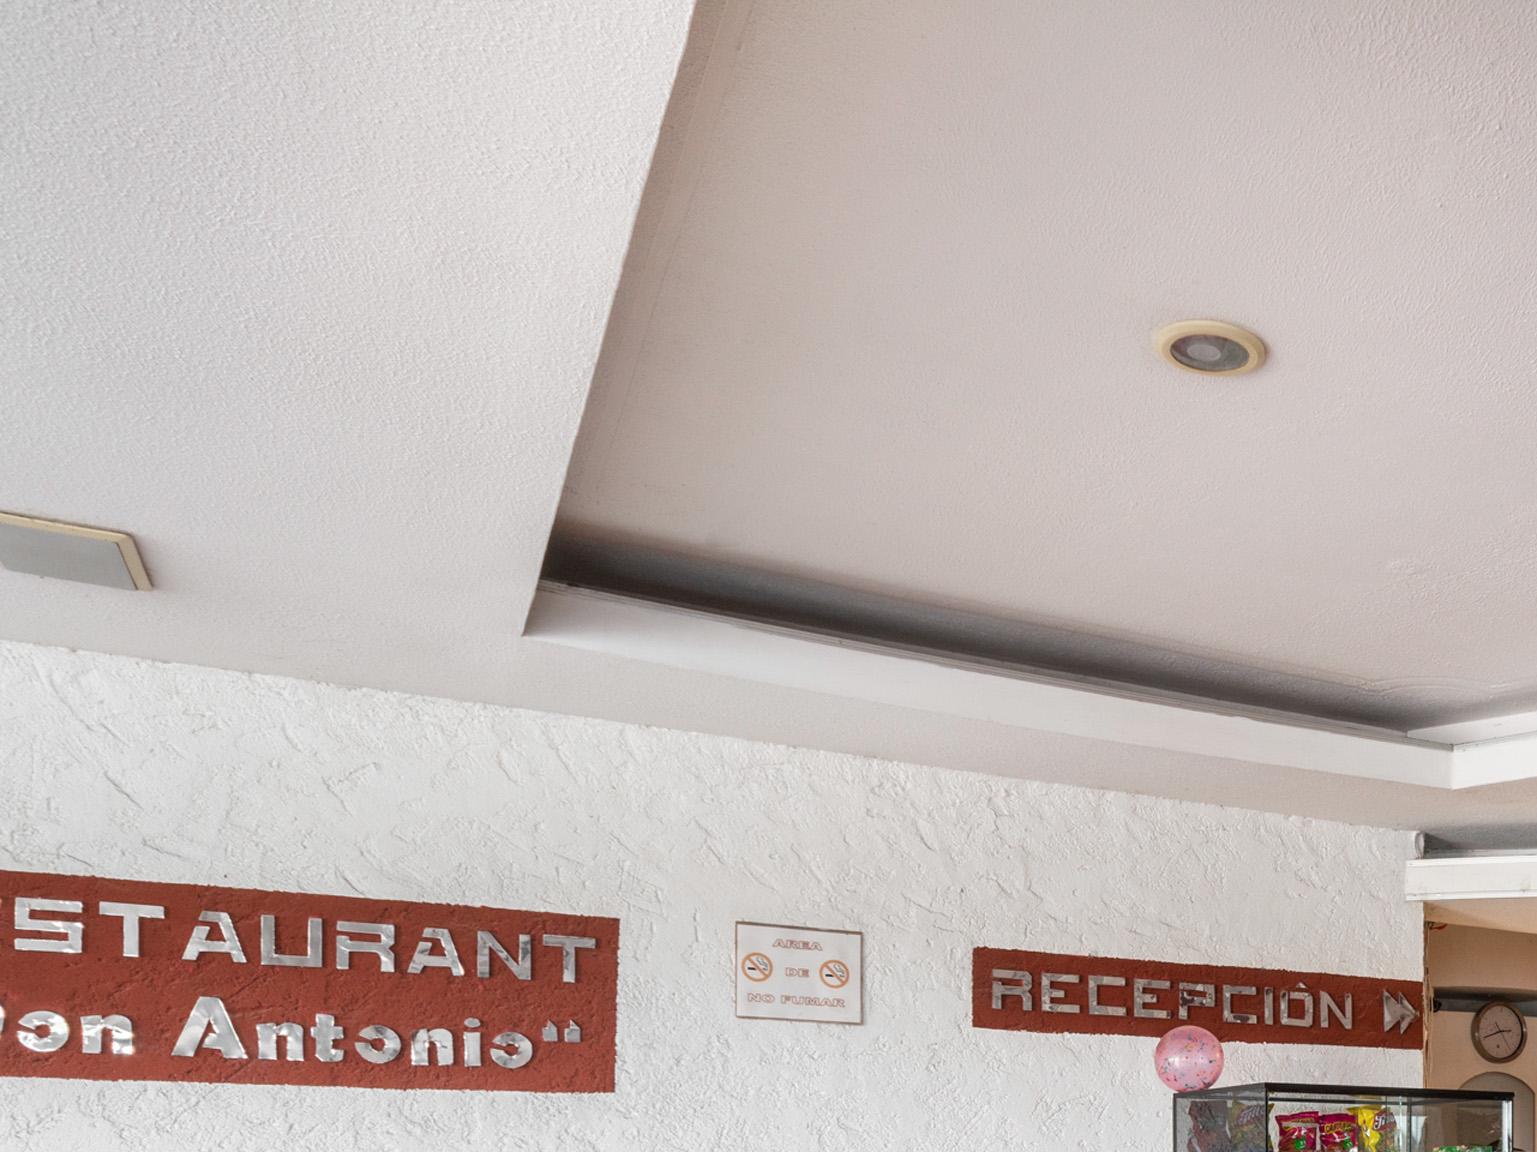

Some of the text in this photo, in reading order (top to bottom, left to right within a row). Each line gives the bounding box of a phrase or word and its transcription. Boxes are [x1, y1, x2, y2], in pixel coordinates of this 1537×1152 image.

[772, 938, 823, 951] AREA
[785, 966, 810, 978] DE
[747, 992, 846, 1008] NO FUMAR
[991, 967, 1353, 1030] RECEPCIÓN
[0, 1004, 135, 1055] on
